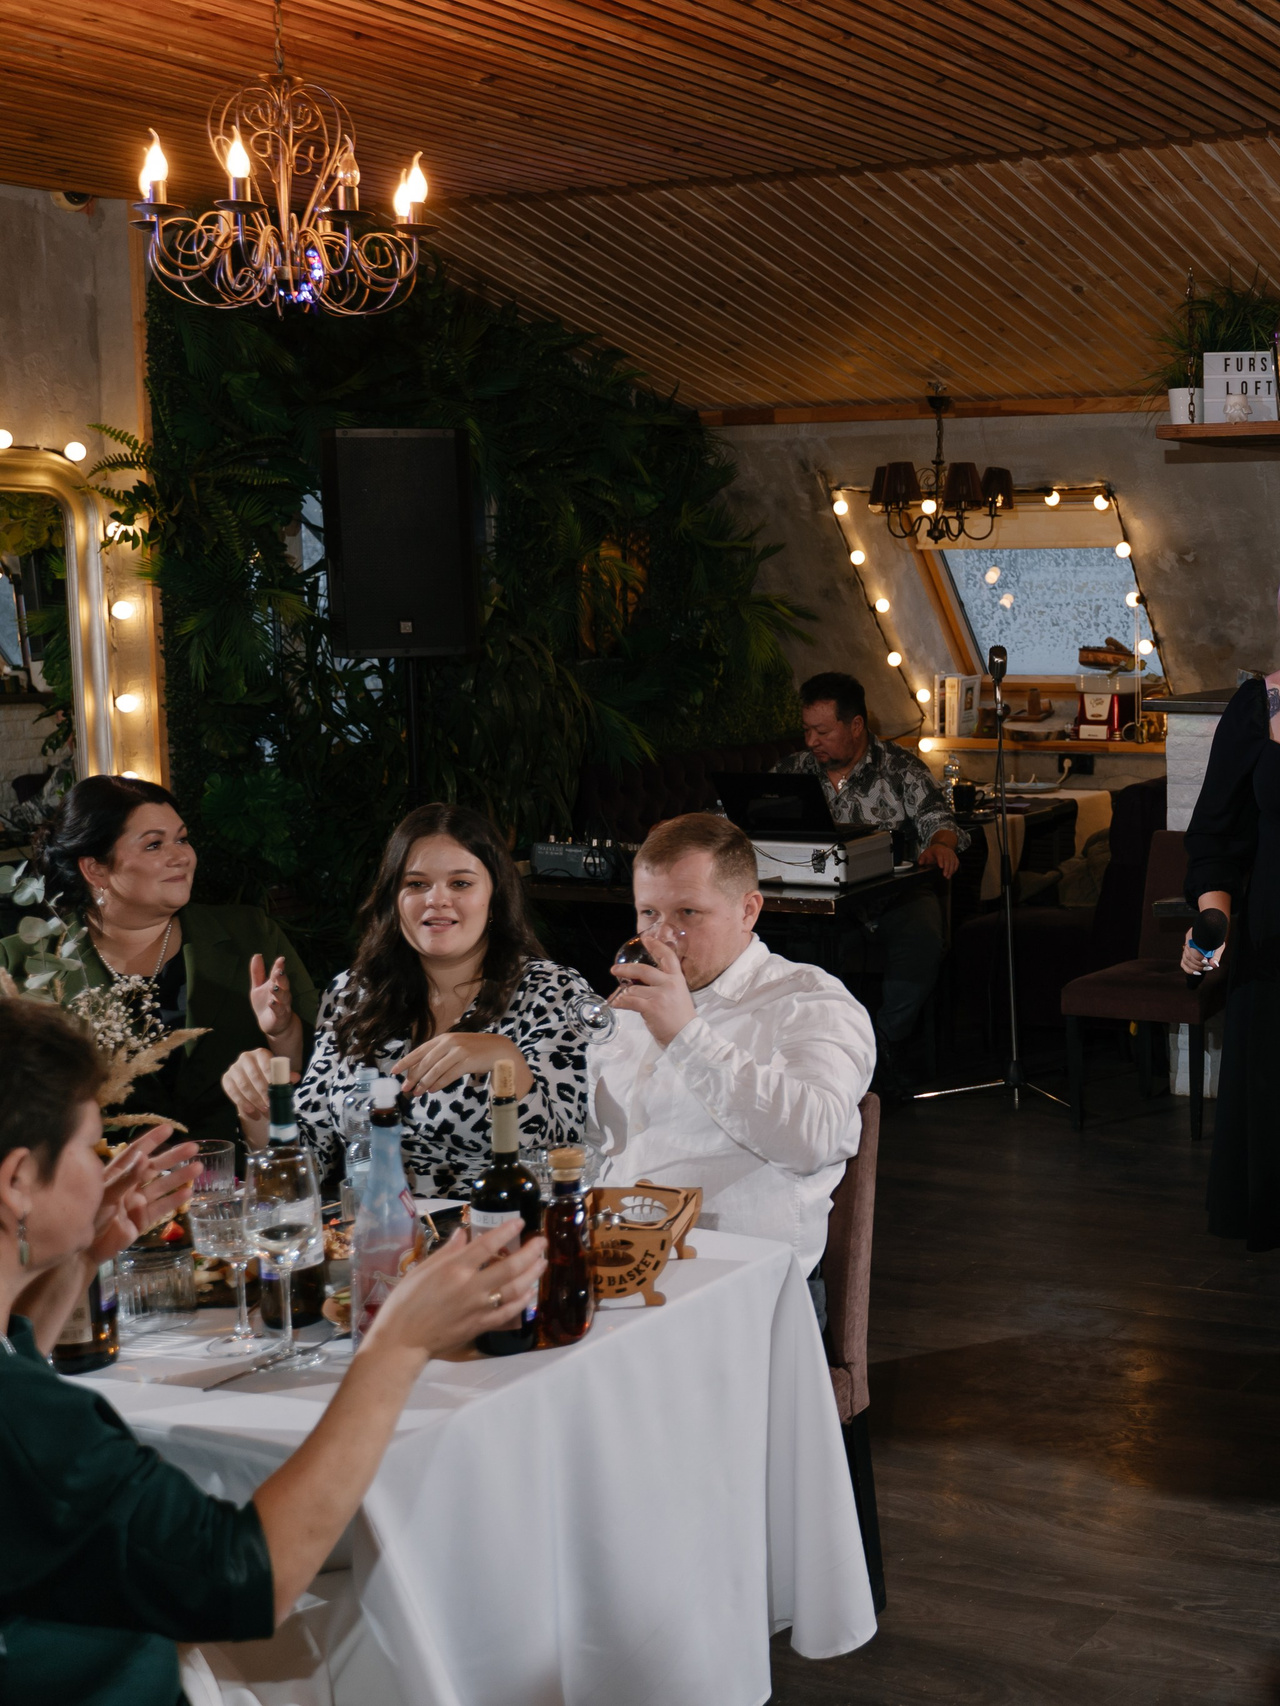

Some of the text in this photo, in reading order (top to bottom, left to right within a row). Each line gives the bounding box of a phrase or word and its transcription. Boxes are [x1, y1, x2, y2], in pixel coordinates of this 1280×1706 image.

[1224, 357, 1268, 372] FURS
[1226, 380, 1273, 395] LOFT
[607, 1249, 655, 1287] BASKET
